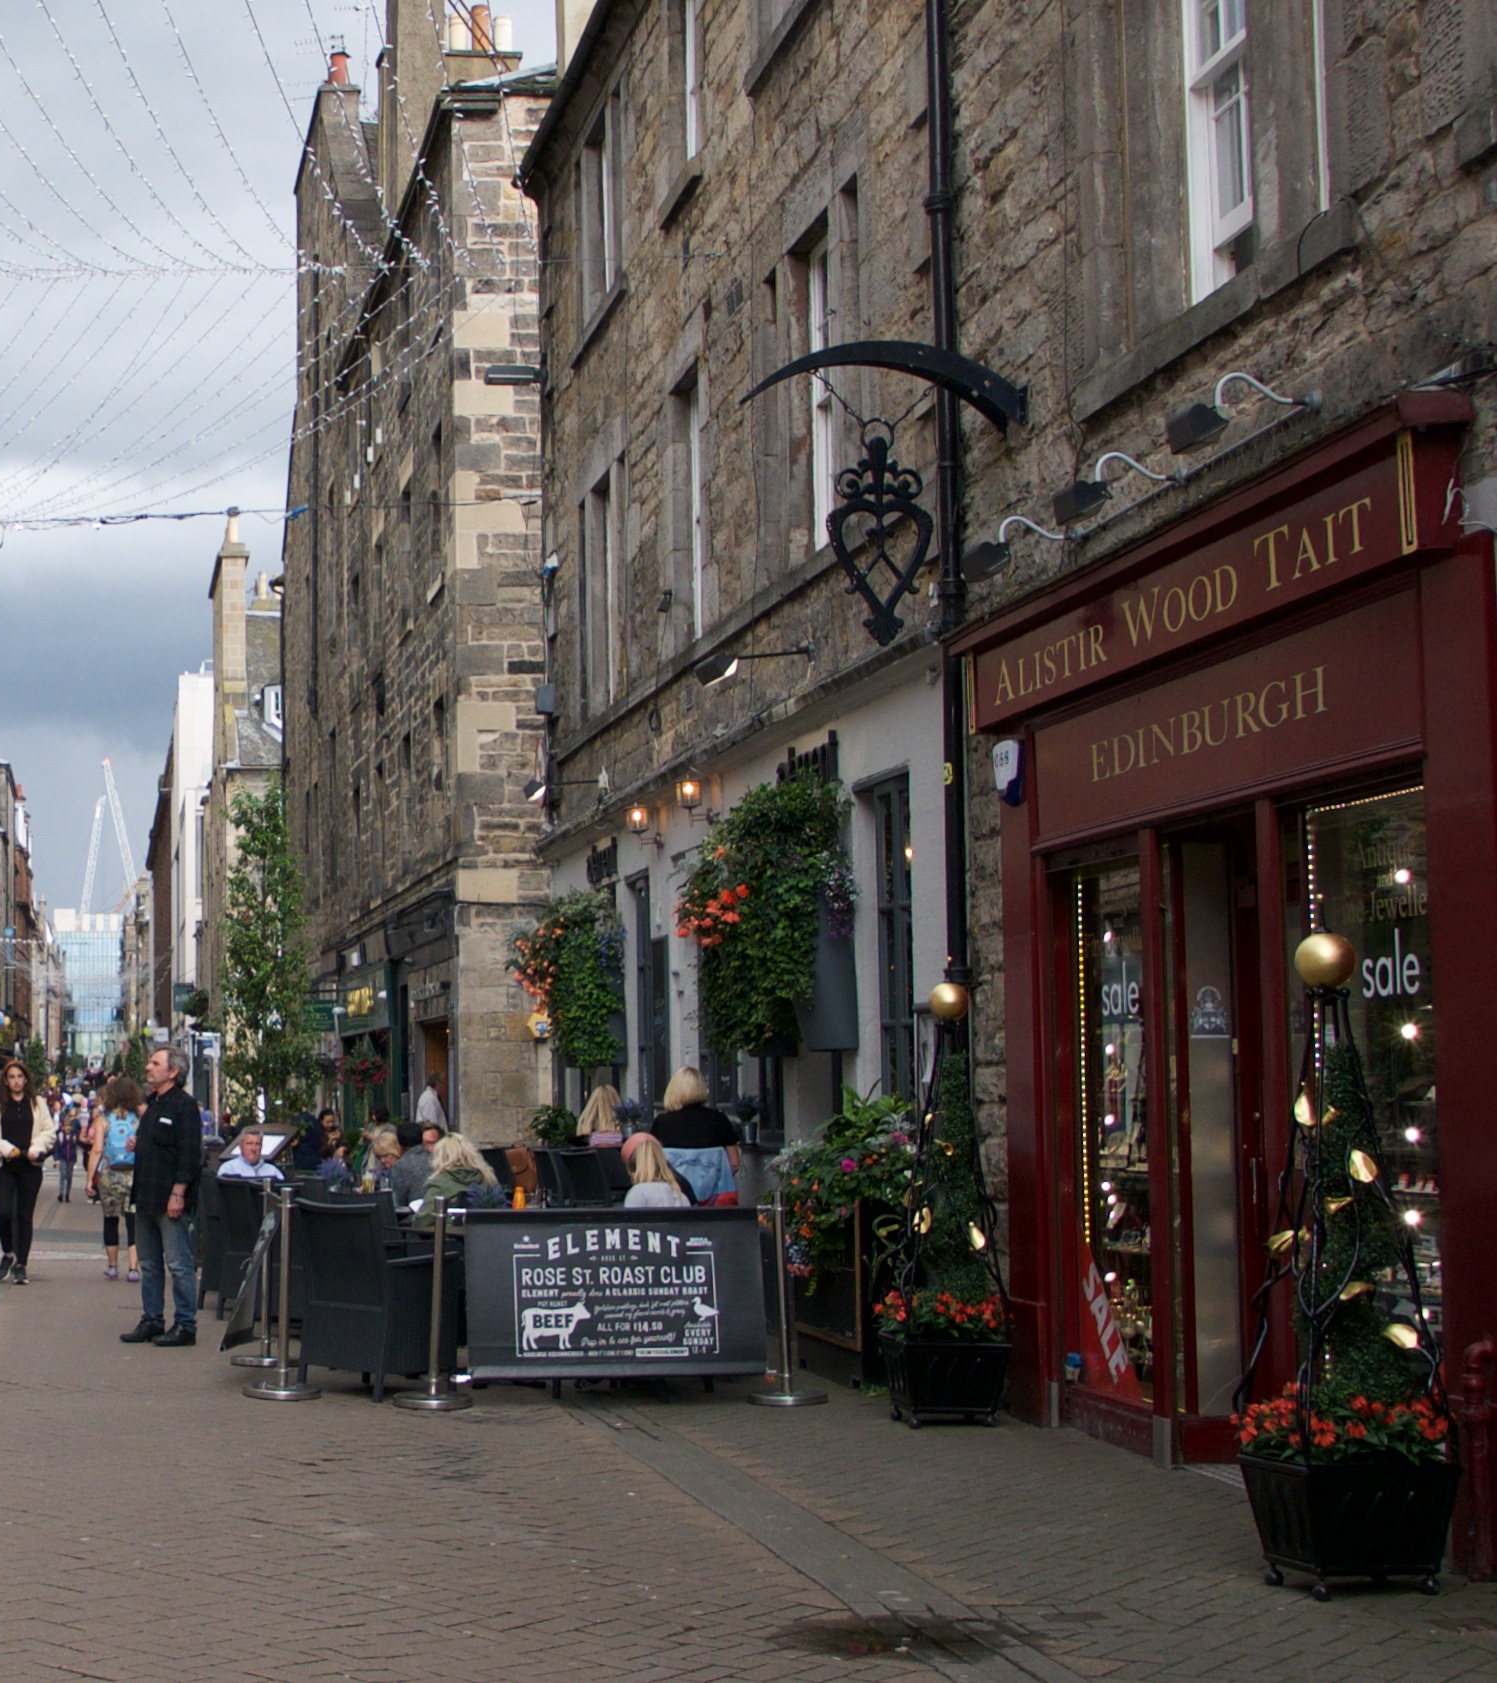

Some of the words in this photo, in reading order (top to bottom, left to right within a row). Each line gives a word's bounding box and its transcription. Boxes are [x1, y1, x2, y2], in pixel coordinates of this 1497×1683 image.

[994, 623, 1108, 706] ALISTIR
[1121, 563, 1238, 648] WOOD
[1253, 496, 1373, 592] TAIT
[1090, 664, 1329, 784] EDINBURGH
[1362, 927, 1421, 998] sale
[1101, 960, 1140, 1016] sale
[547, 1228, 680, 1260] ELEMENT
[521, 1267, 567, 1286] ROSE
[599, 1265, 655, 1285] ROAST
[660, 1265, 706, 1284] CLUB
[521, 1288, 559, 1298] ELEMENT
[612, 1287, 646, 1296] CLASSIC
[648, 1287, 680, 1296] SUNDAY
[682, 1287, 709, 1296] ROAST
[533, 1313, 574, 1329] BEEF
[596, 1321, 613, 1332] ALL
[615, 1321, 631, 1331] FOR
[1082, 1261, 1129, 1385] SALE
[682, 1337, 715, 1346] SUNDAY
